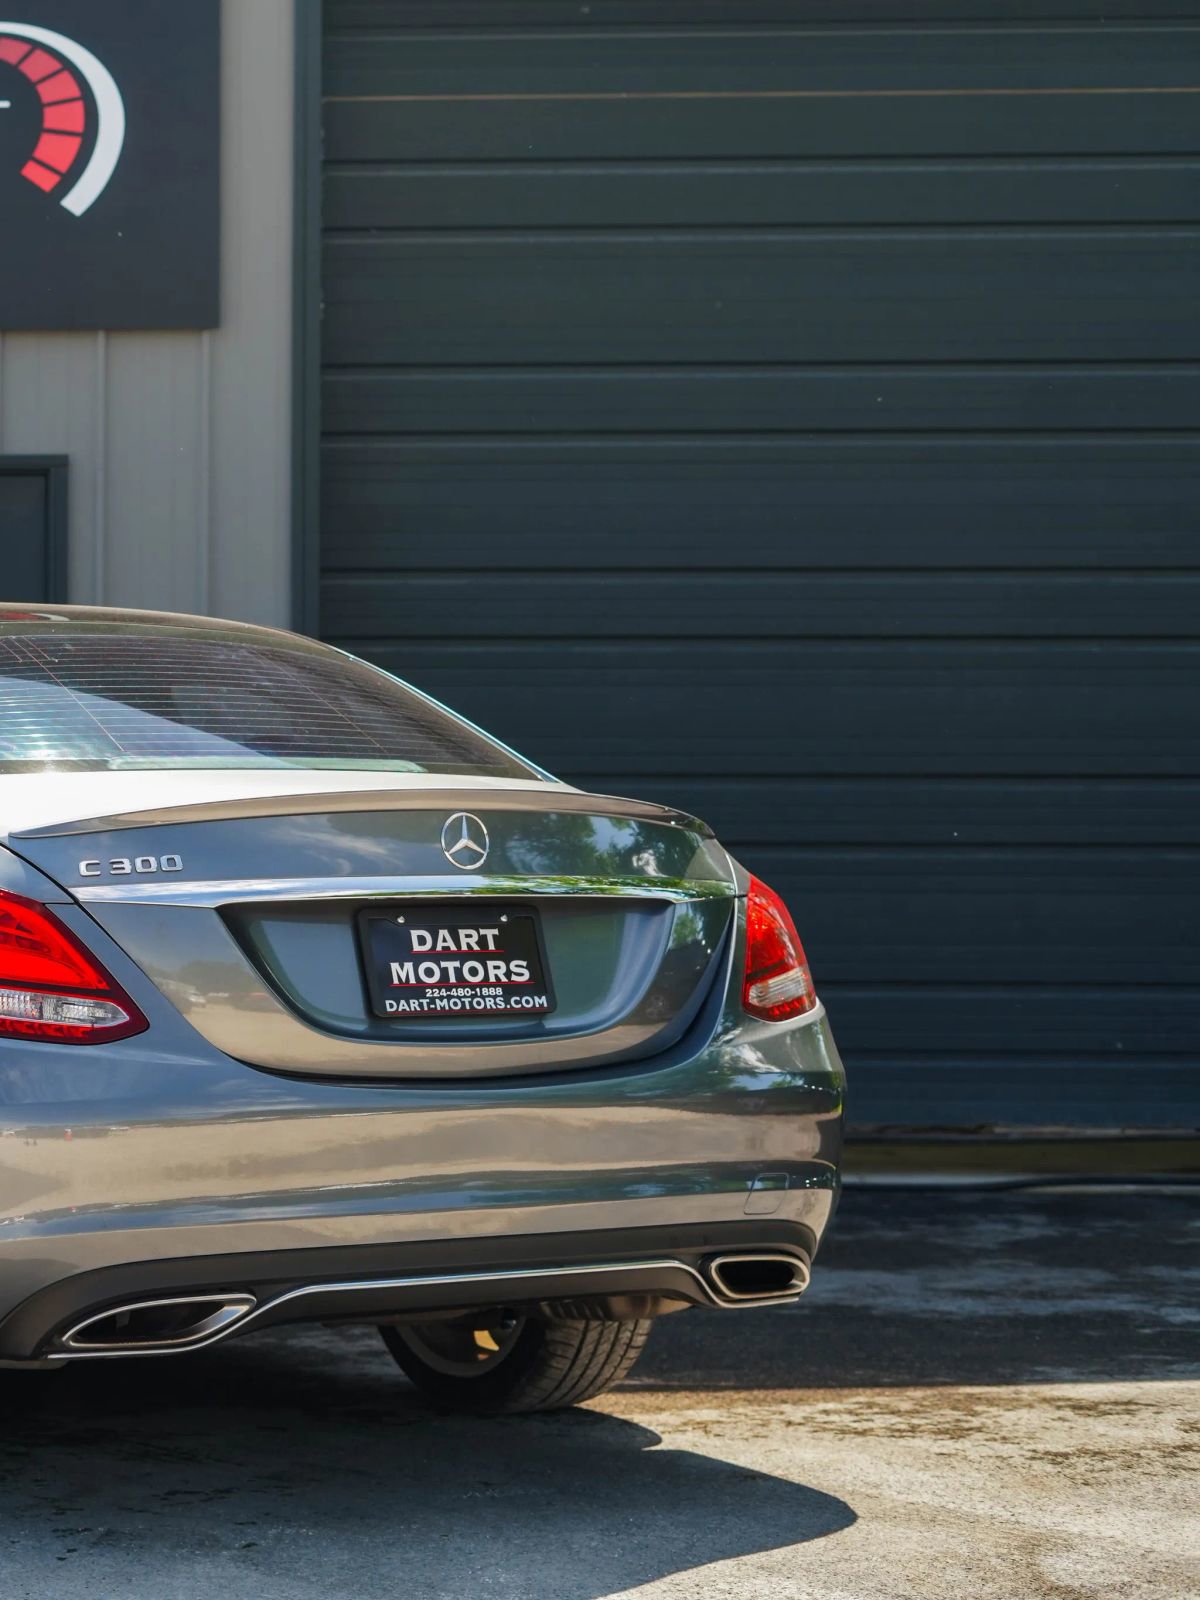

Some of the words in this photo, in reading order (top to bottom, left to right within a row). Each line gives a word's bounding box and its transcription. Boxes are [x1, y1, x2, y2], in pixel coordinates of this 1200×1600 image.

[78, 859, 101, 877] C
[108, 854, 184, 875] 300
[409, 928, 500, 952] DART
[389, 959, 531, 984] MOTORS
[385, 995, 548, 1012] DART-MOTORS.COM
[425, 987, 503, 998] 224-480-1888
